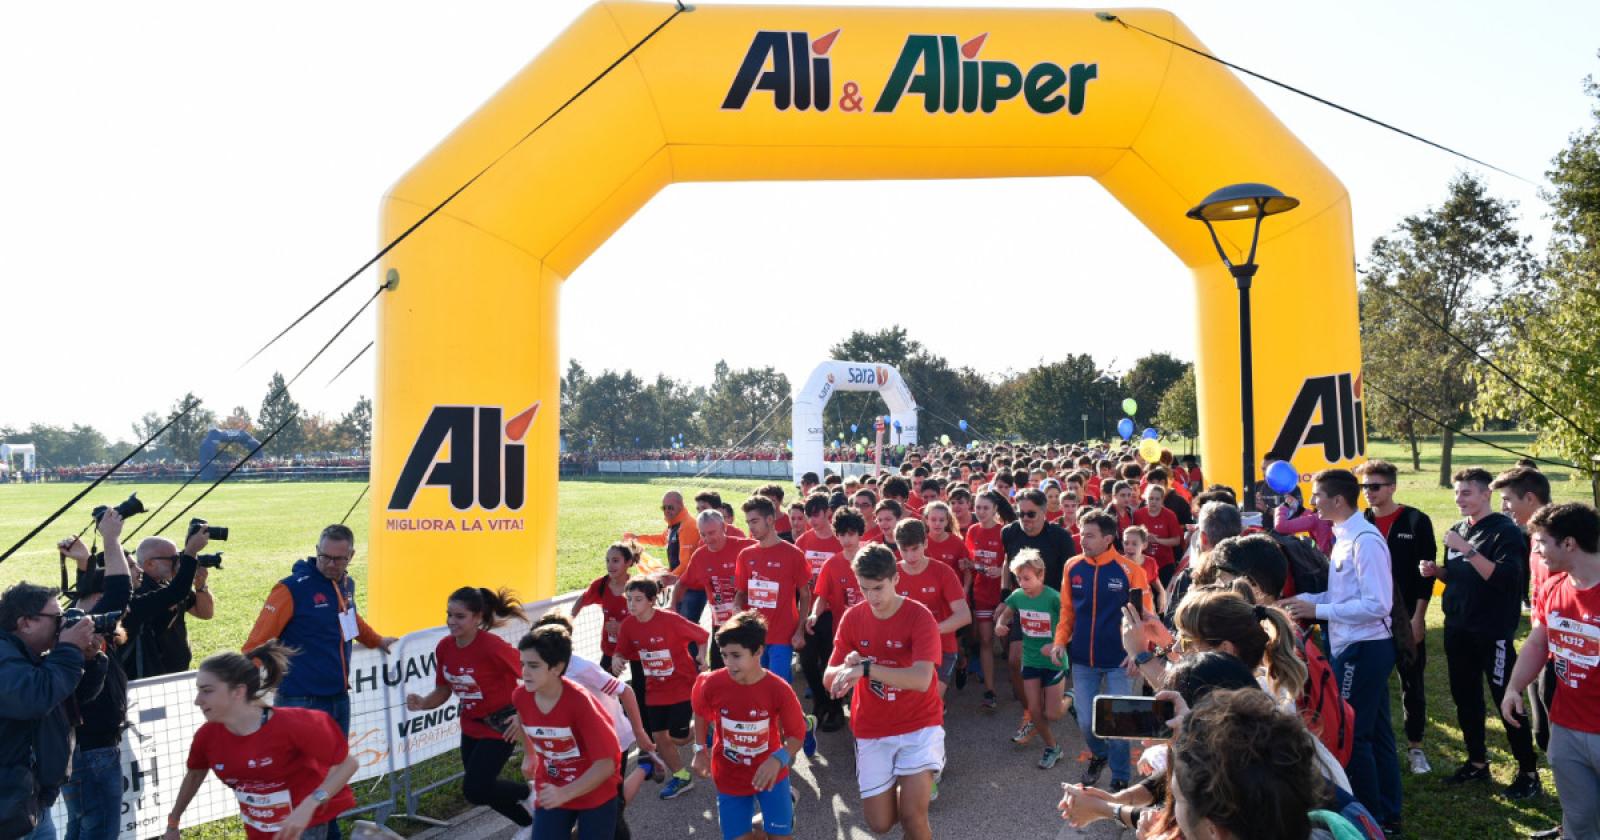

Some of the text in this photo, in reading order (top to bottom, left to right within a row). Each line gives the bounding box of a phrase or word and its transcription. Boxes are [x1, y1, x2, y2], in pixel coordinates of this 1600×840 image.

[839, 82, 863, 112] &
[848, 367, 875, 385] sara
[386, 519, 524, 531] MIGLIORA LA VITA!
[1492, 639, 1506, 687] LEGEA
